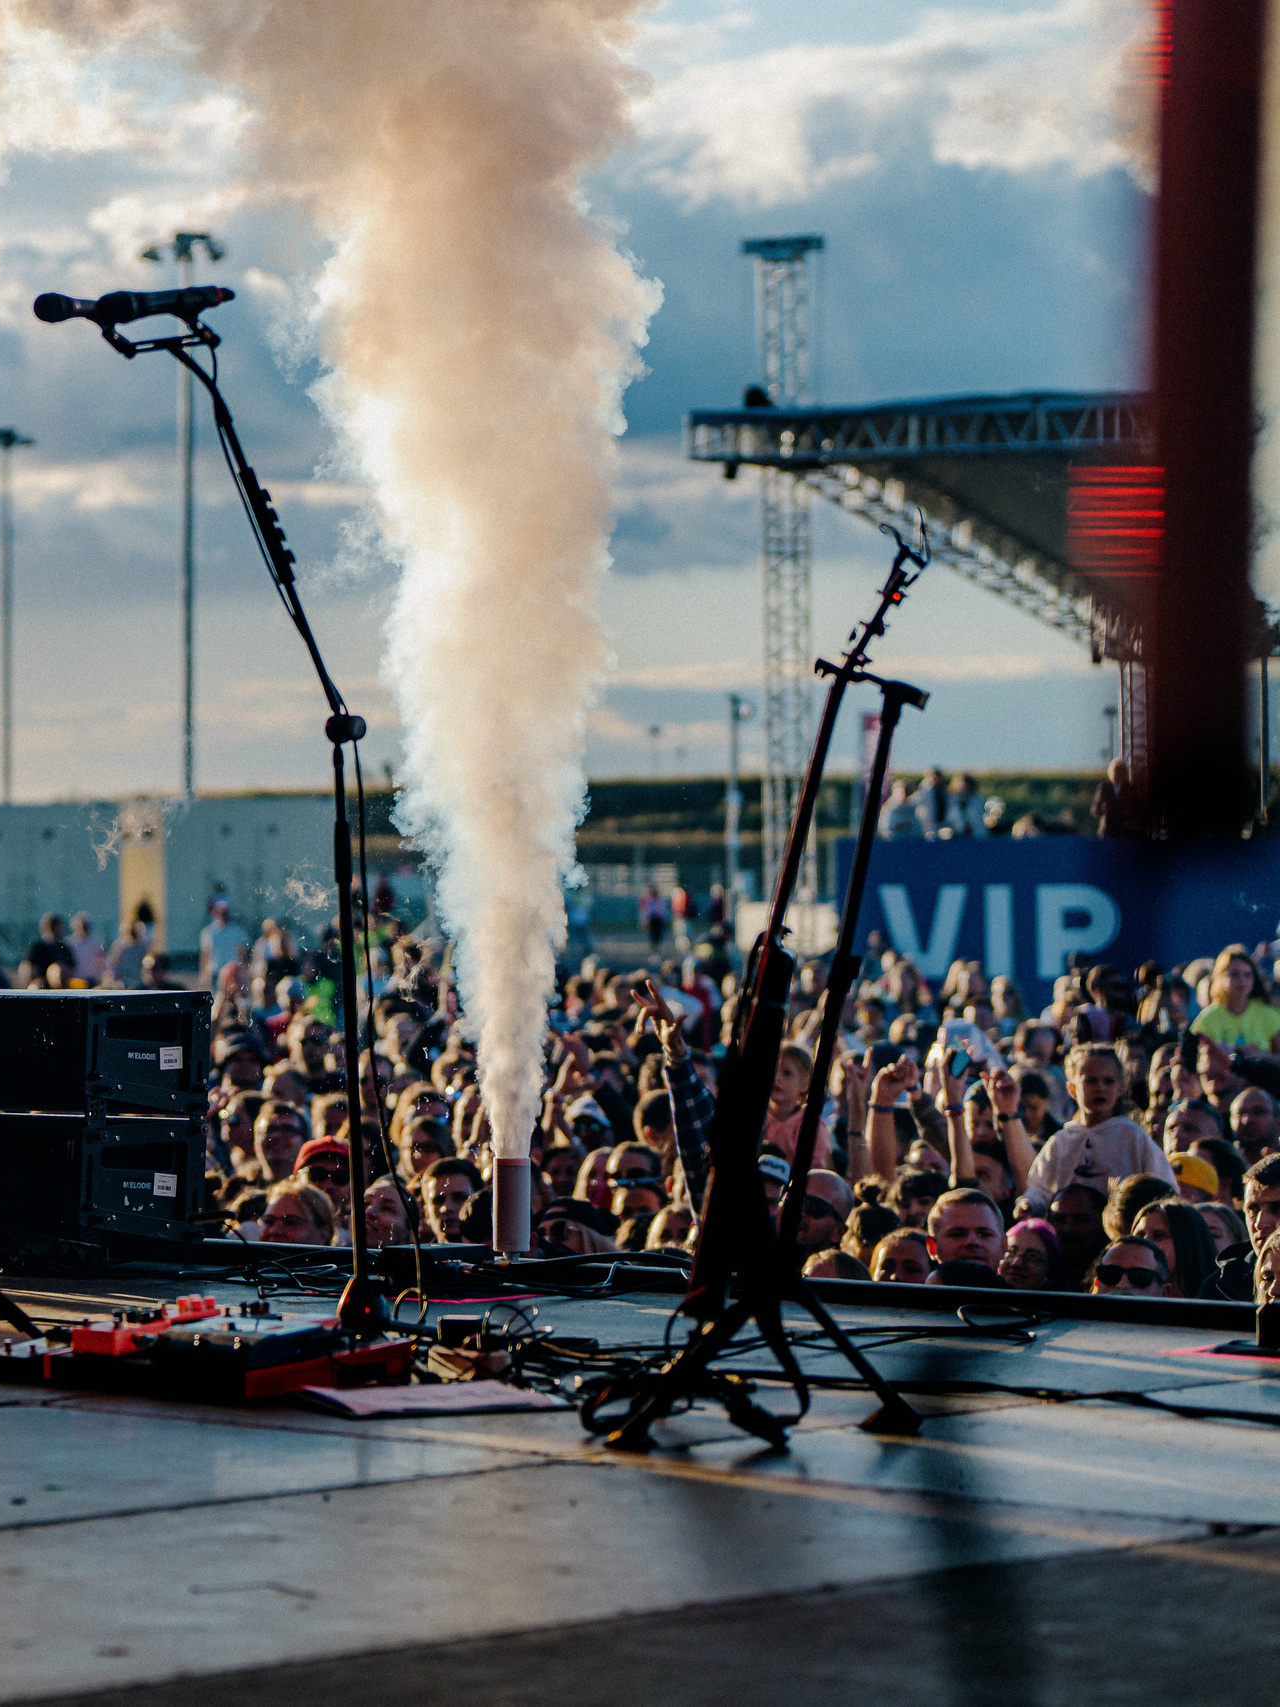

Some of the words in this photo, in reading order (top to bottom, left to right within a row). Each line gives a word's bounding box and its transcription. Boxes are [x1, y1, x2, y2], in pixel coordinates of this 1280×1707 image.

[877, 882, 1121, 980] VIP
[127, 1051, 157, 1060] MELODIE
[122, 1181, 152, 1190] MELODIE
